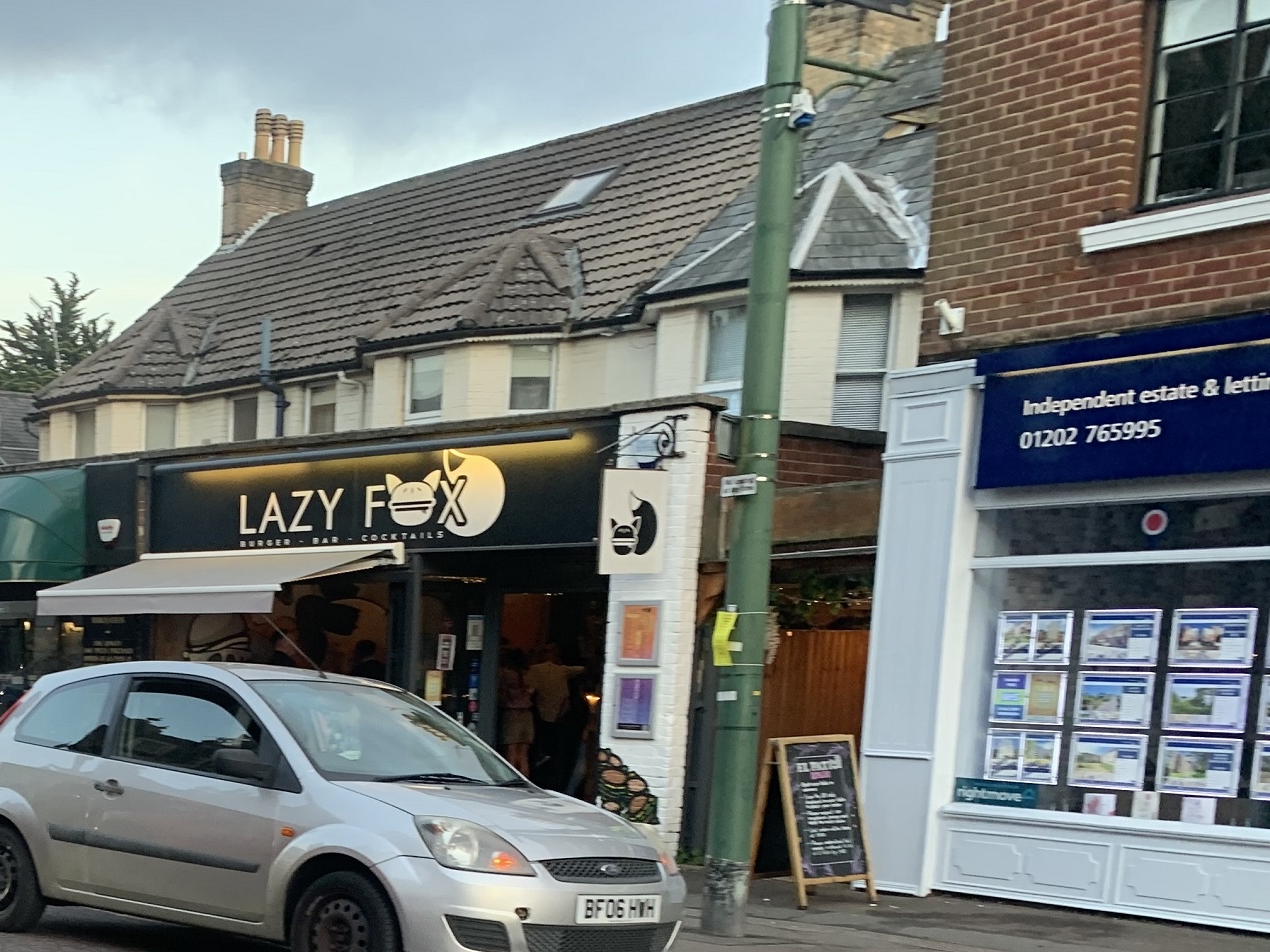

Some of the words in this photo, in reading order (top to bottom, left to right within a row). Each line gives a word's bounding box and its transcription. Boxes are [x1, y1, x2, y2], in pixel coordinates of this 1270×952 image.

[1022, 389, 1135, 416] Independent
[1139, 383, 1199, 403] estate
[1202, 378, 1219, 396] &
[1019, 427, 1078, 449] 01202
[1085, 419, 1162, 443] 765995
[239, 487, 345, 535] LAZY
[239, 538, 291, 548] BURGER
[313, 536, 339, 545] BAR
[361, 530, 445, 542] COCKTAILS
[956, 785, 1022, 802] rightmove
